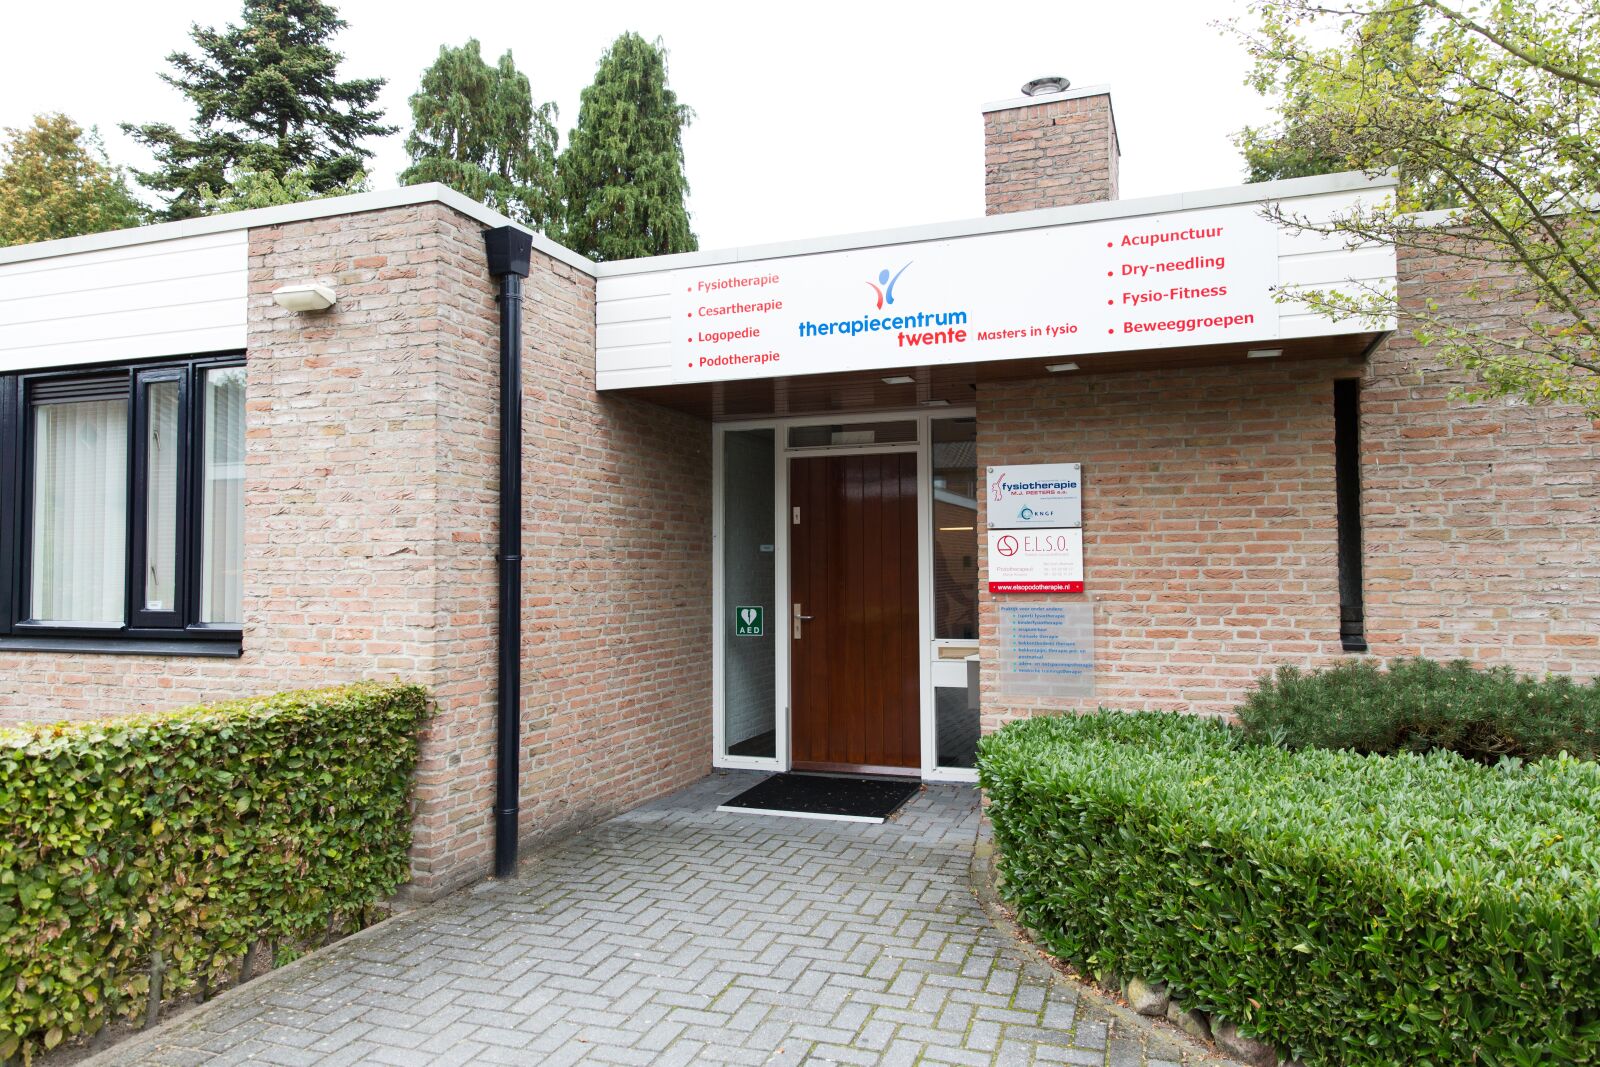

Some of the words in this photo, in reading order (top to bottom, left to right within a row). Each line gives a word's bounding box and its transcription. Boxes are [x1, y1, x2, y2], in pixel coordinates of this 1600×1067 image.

[1121, 225, 1224, 249] Acupunctuur
[1122, 253, 1226, 278] Dry-needling
[698, 273, 780, 294] Fysiotherapie
[1122, 283, 1228, 308] Fysio-Fitness
[698, 299, 783, 318] Cesartherapie
[799, 309, 968, 338] therapiecentrum
[977, 328, 1028, 341] Masters
[1030, 326, 1042, 338] in
[1044, 322, 1078, 338] fysio
[1123, 312, 1255, 337] Beweeggroepen
[698, 326, 761, 345] Logopedie
[898, 326, 968, 348] twente
[699, 350, 781, 368] Podotherapie
[1002, 480, 1077, 491] fysiotherapie
[1024, 535, 1069, 552] E.L.S.O.
[997, 583, 1071, 592] www.elsopodotherapie.nl
[739, 626, 760, 634] AED
